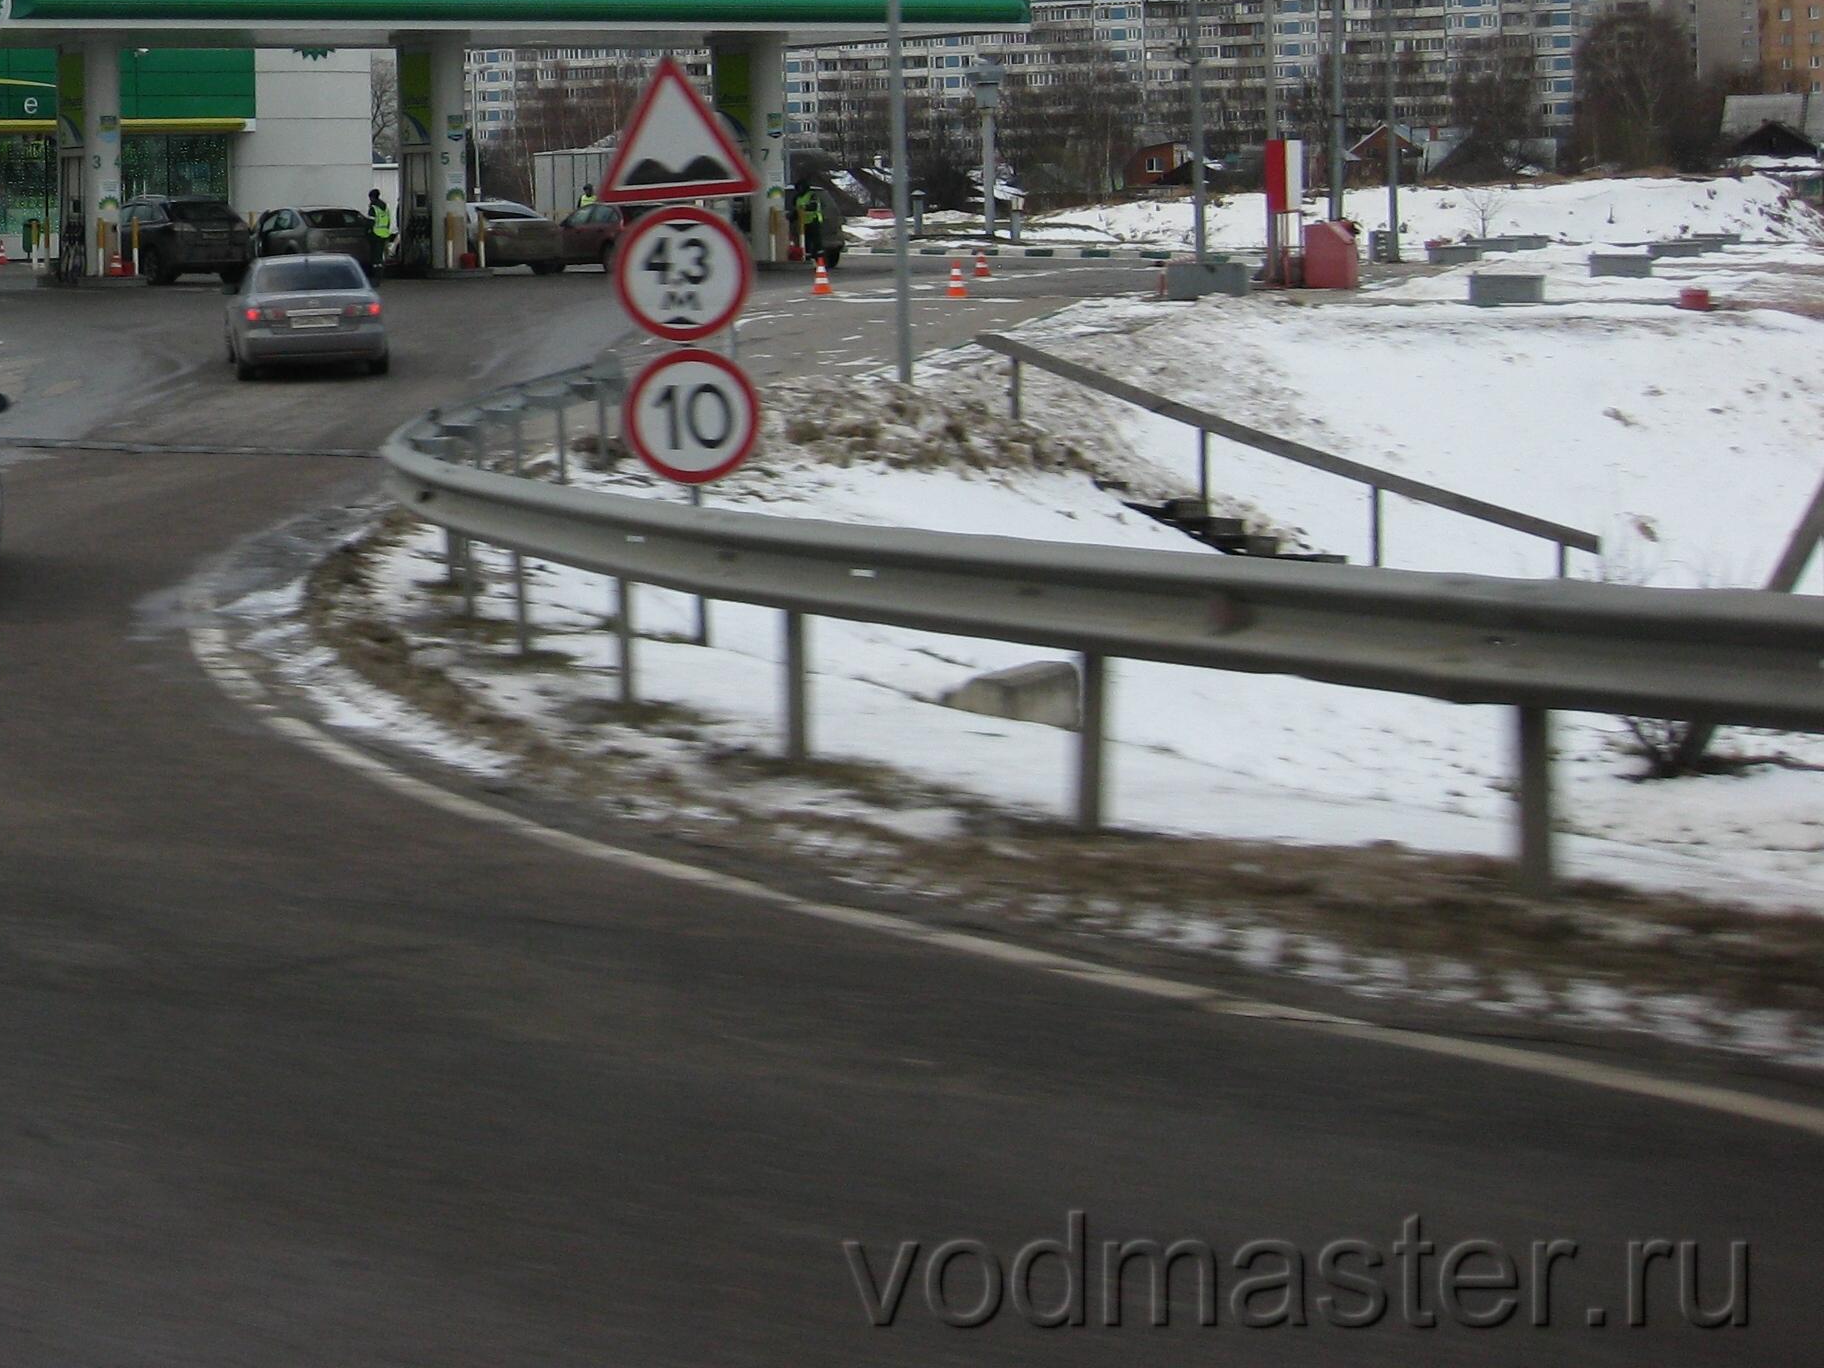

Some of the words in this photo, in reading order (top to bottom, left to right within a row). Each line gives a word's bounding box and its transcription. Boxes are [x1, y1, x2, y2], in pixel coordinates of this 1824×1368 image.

[440, 152, 449, 165] 5
[761, 149, 769, 160] 7
[92, 155, 101, 169] 3
[652, 384, 731, 449] 10
